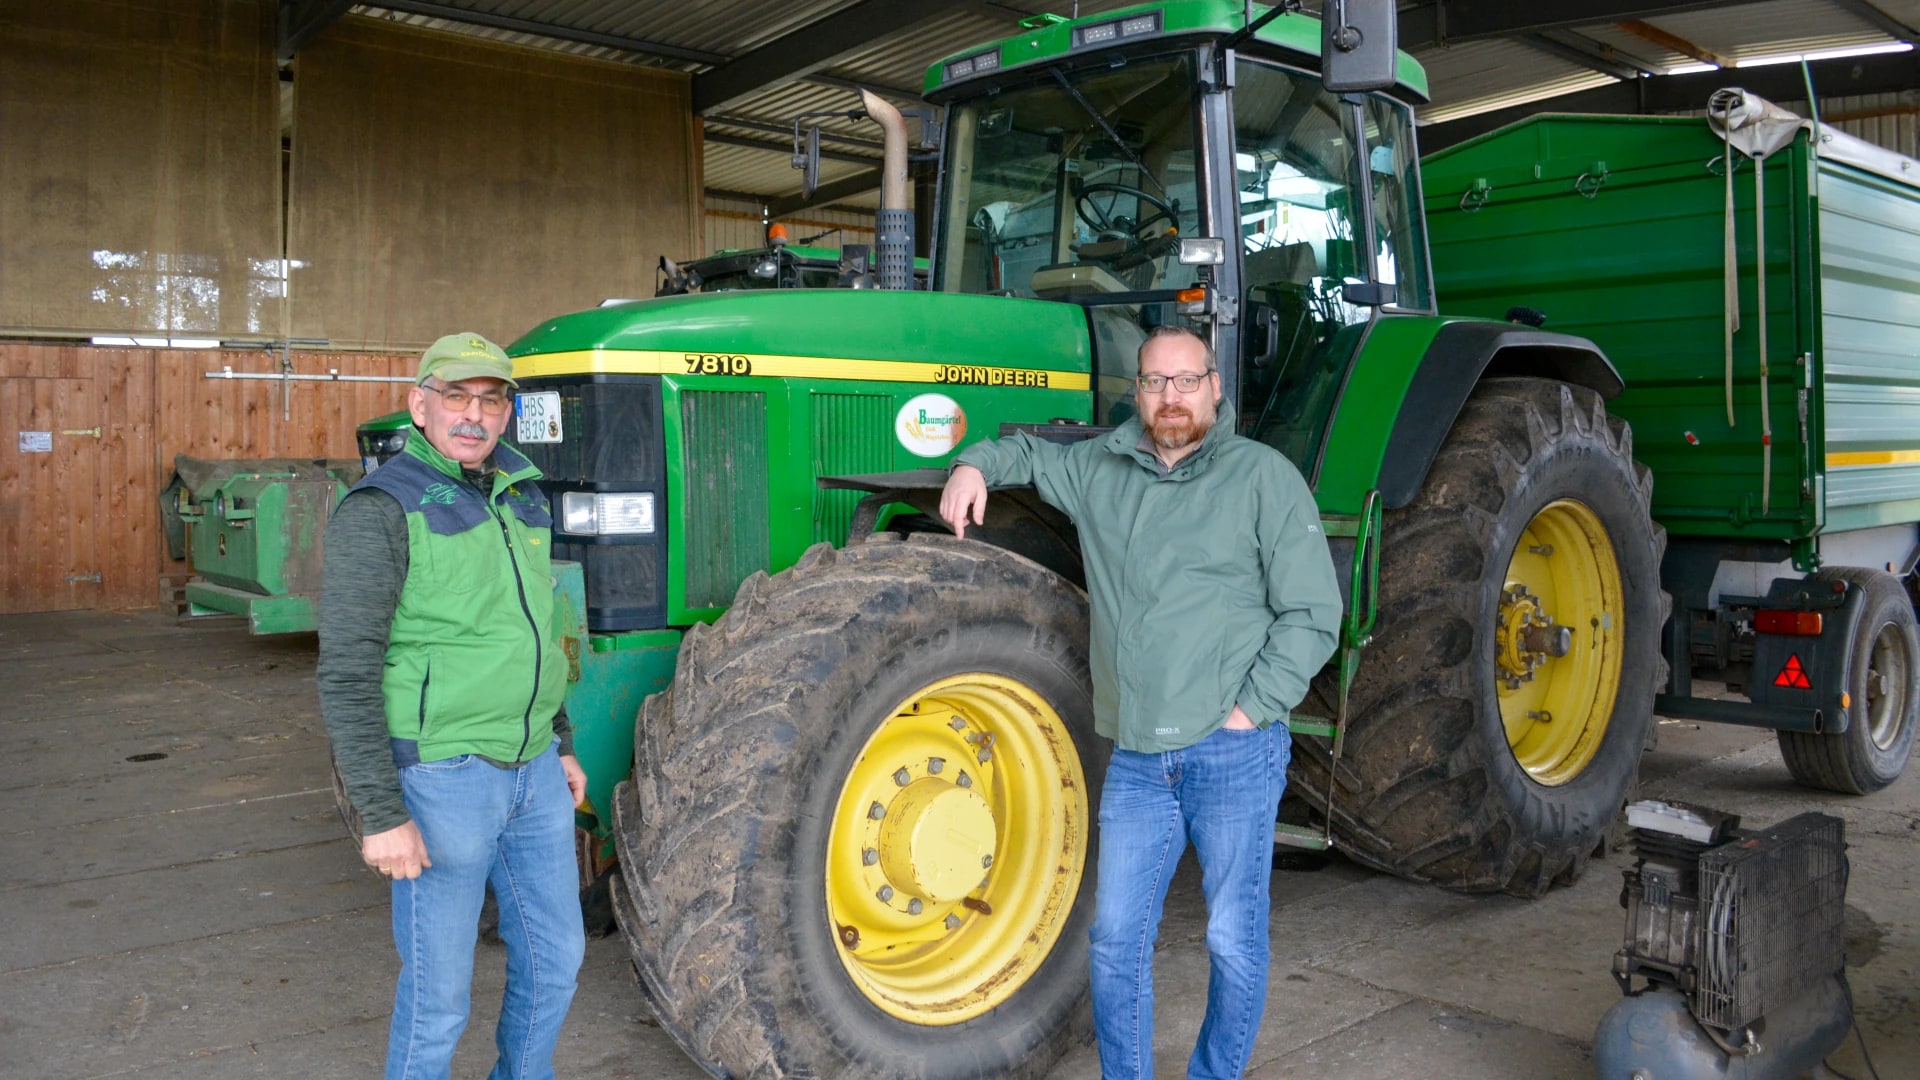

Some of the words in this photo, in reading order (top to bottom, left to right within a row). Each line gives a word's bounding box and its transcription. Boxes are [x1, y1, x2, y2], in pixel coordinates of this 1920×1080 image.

[685, 354, 751, 375] 7810
[934, 365, 988, 385] JOHN
[992, 369, 1048, 388] DEERE
[524, 396, 544, 416] HBS
[919, 409, 961, 426] Baumgärtel
